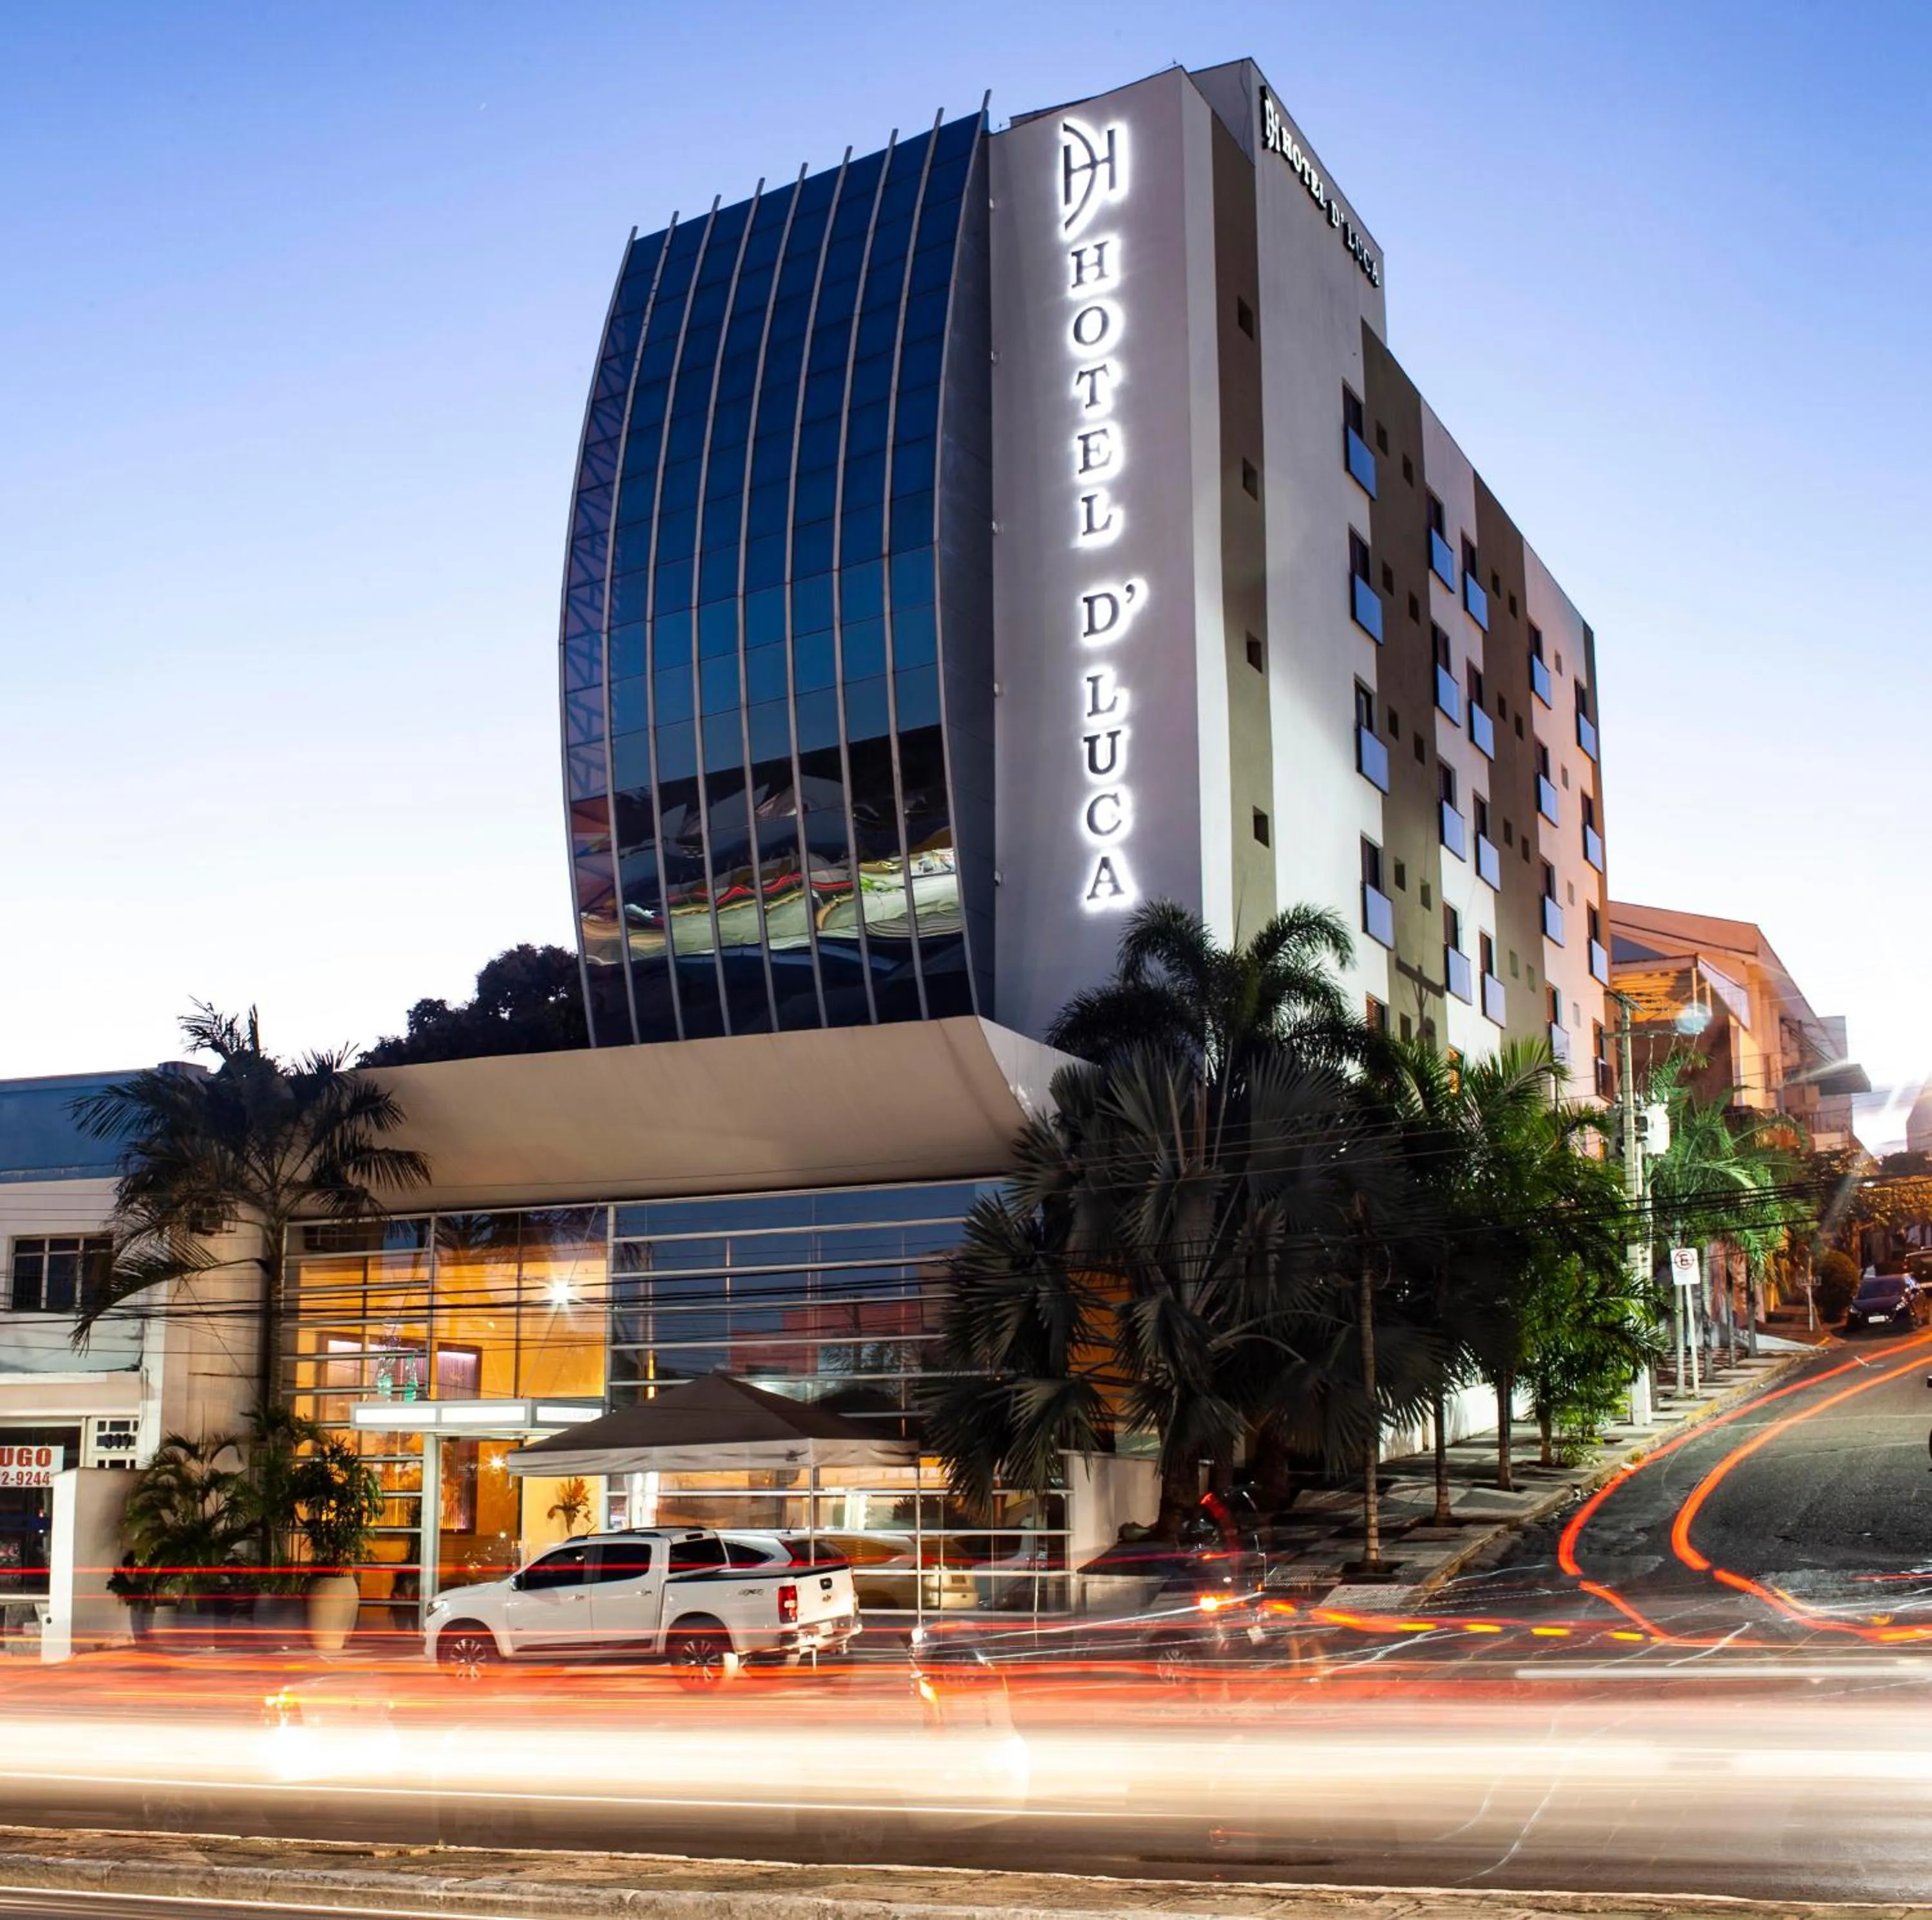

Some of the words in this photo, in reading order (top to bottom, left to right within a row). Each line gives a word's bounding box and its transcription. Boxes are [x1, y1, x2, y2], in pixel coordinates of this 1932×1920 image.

[1280, 126, 1327, 209] HOTEL
[1070, 240, 1113, 536] HOTEL
[1083, 673, 1126, 901] LUCA
